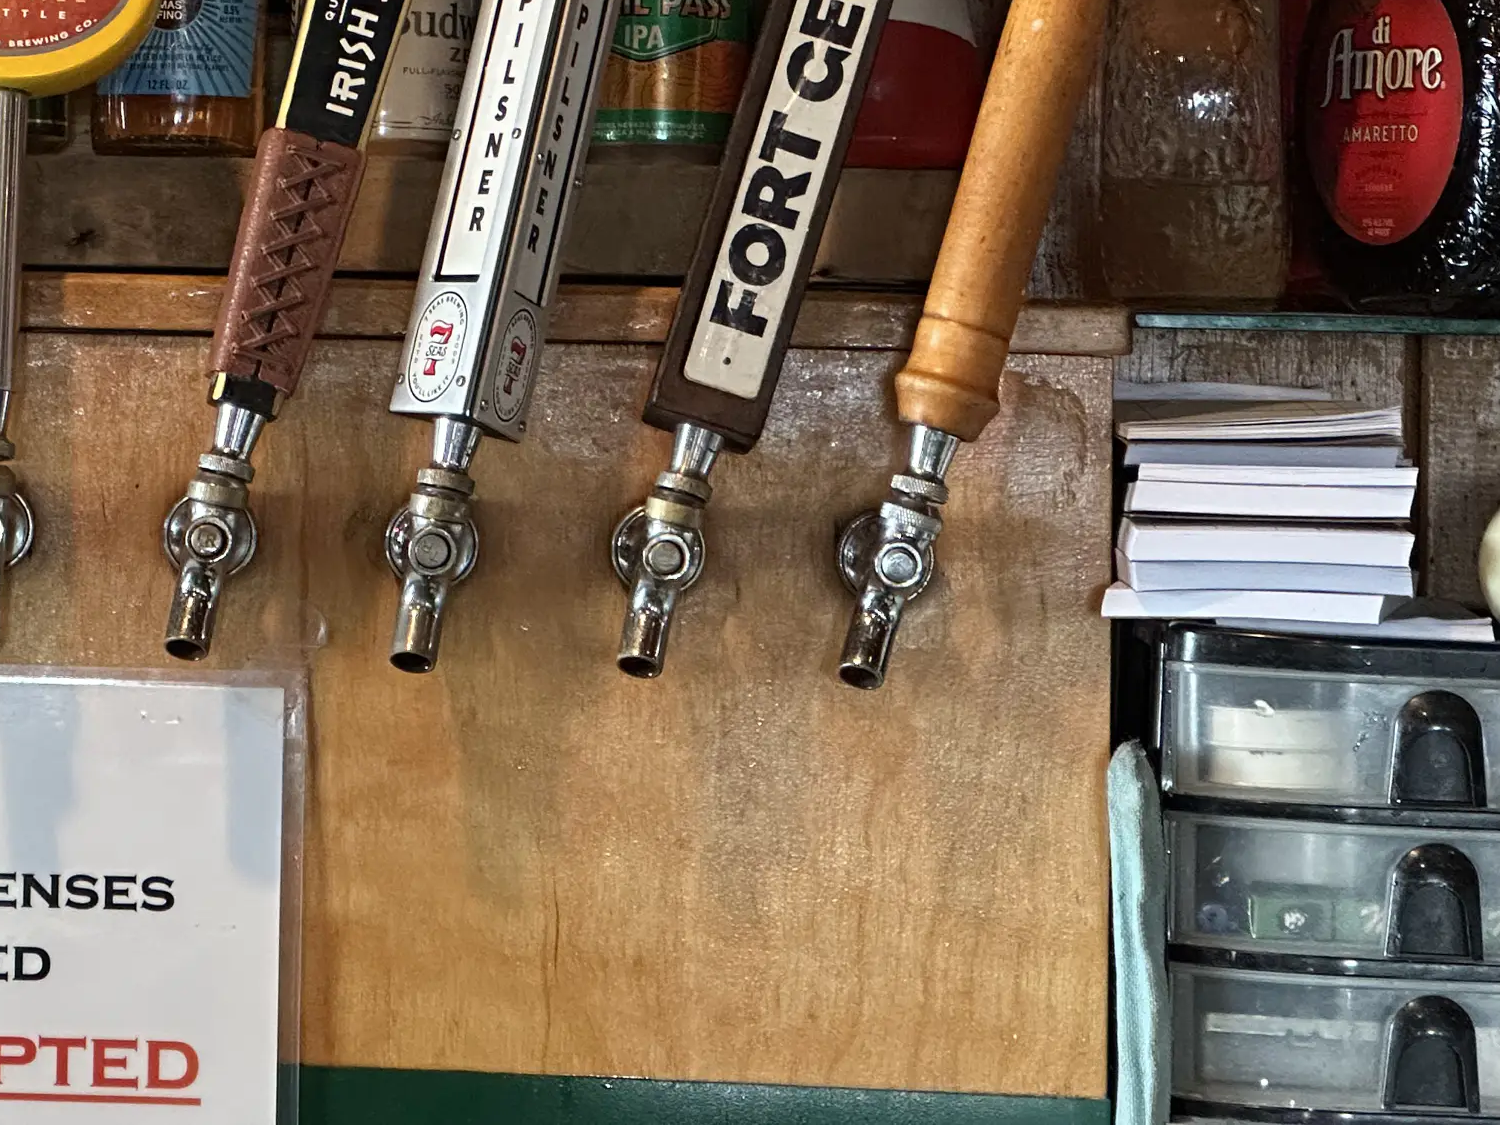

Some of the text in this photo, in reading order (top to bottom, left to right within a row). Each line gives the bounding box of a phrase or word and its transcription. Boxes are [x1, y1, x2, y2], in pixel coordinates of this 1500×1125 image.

[8, 30, 69, 48] BREWING
[75, 17, 99, 34] CO.
[624, 24, 665, 50] IPA
[1371, 15, 1391, 47] di
[325, 8, 380, 118] IRISH
[1320, 24, 1443, 109] Amore
[147, 79, 156, 90] 12
[527, 2, 591, 255] PILSNER
[1342, 124, 1419, 143] AMARETTO
[708, 111, 823, 340] FORT
[425, 344, 448, 357] SEAS
